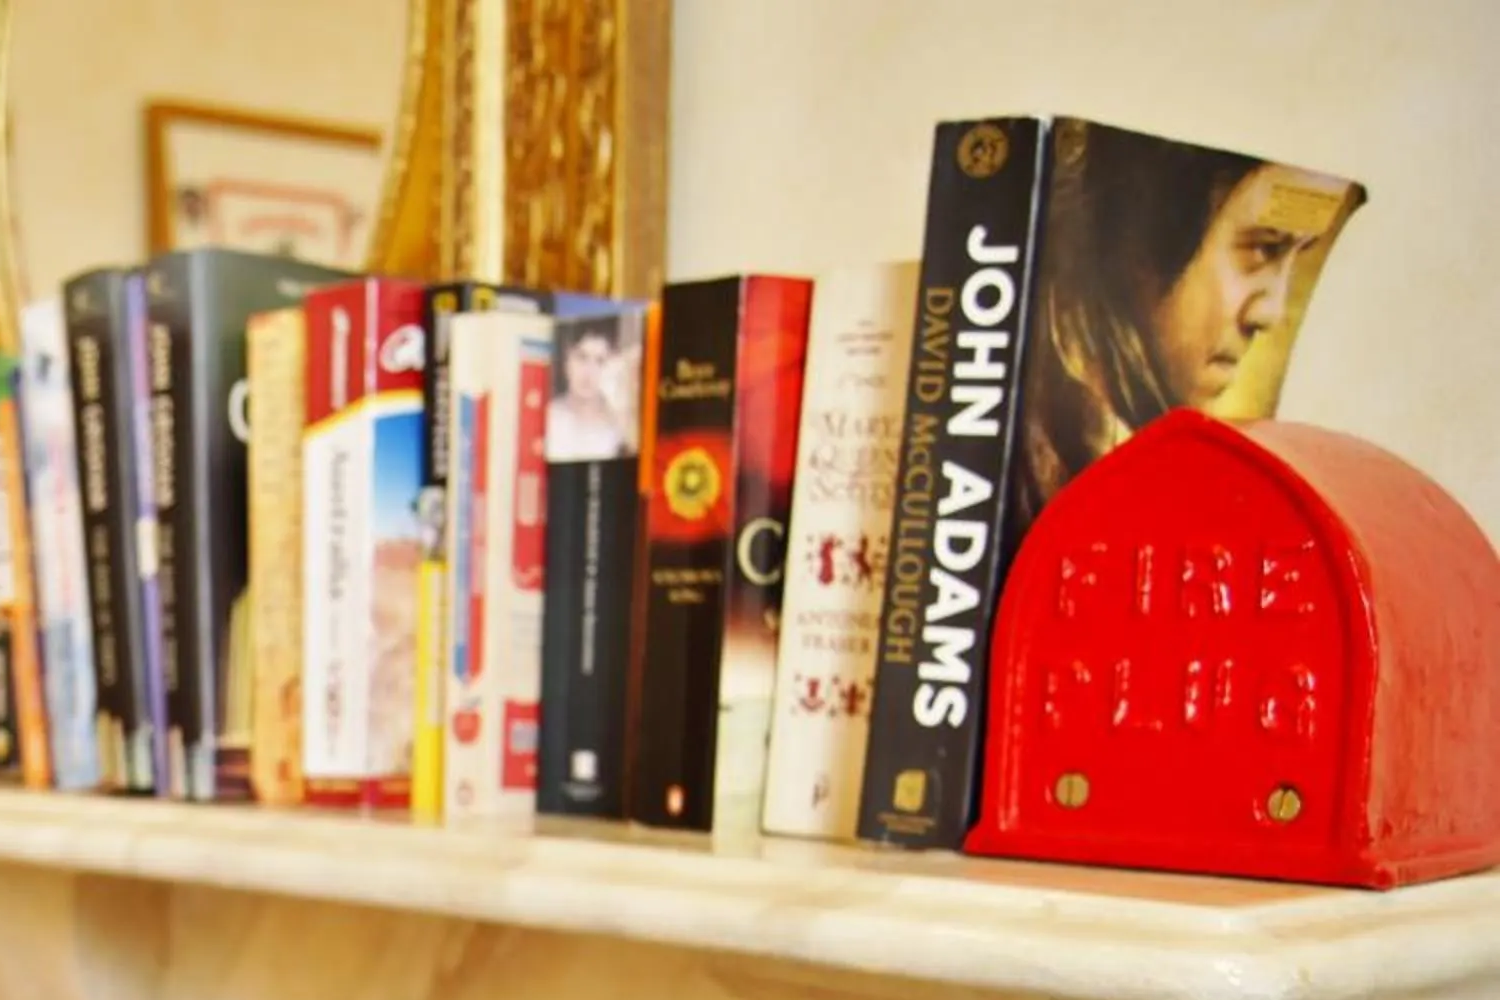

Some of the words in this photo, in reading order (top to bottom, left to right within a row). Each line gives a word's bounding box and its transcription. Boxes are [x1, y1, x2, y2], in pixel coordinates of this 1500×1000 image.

[915, 287, 954, 403] DAVID
[946, 224, 1019, 437] JOHN
[912, 460, 994, 728] ADAMS
[1056, 538, 1316, 618] FIRE
[1042, 656, 1317, 740] PLUG
